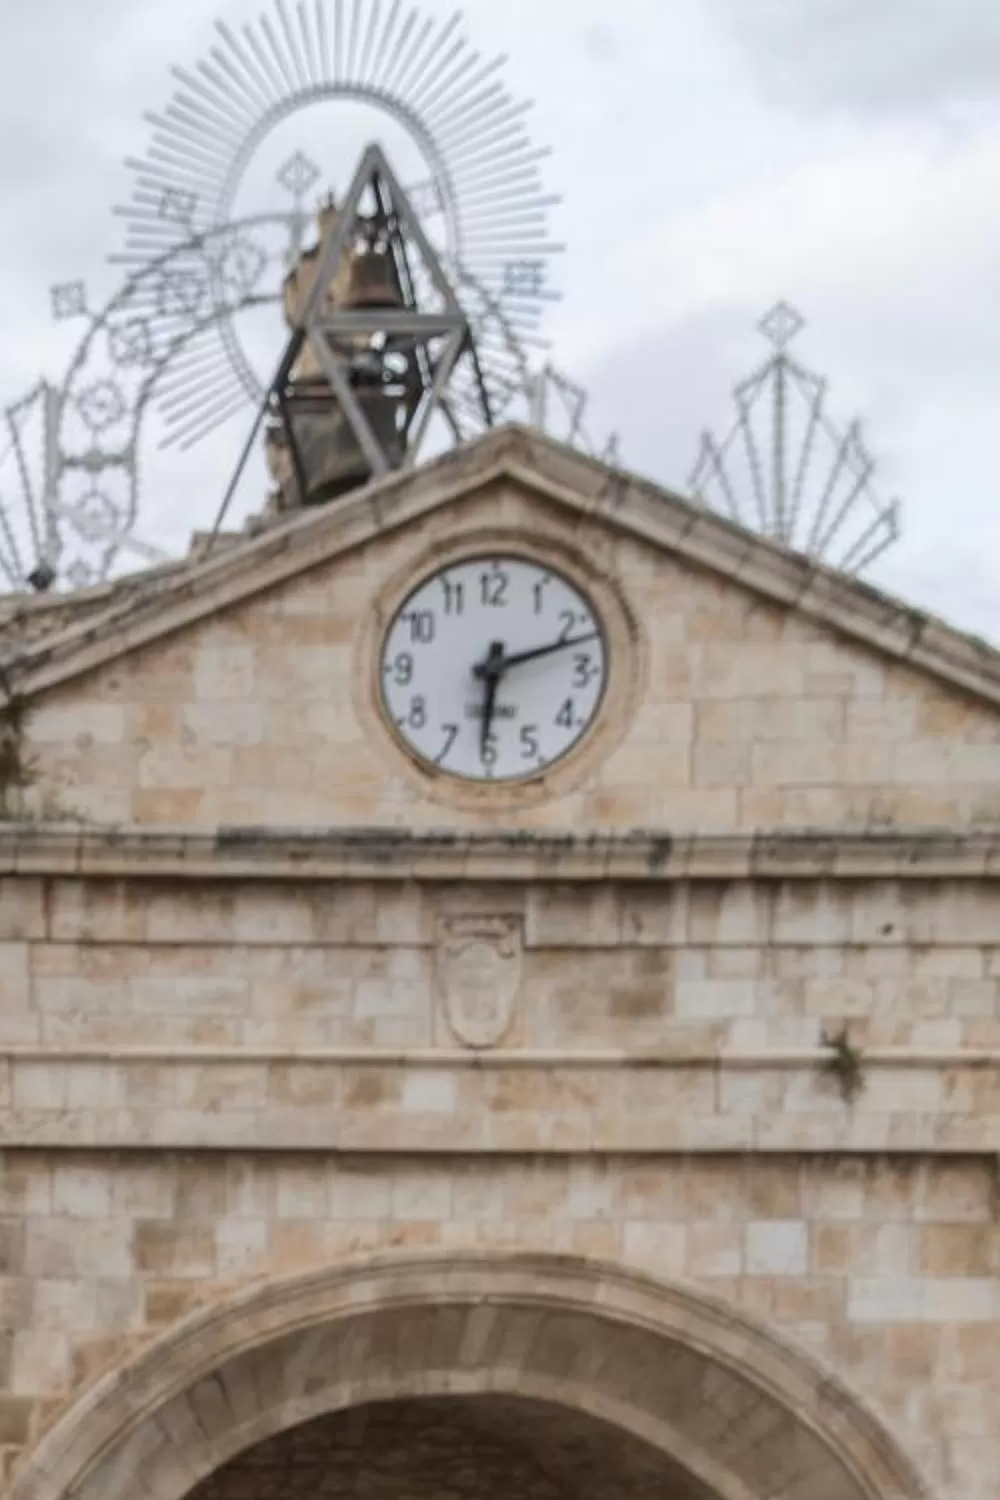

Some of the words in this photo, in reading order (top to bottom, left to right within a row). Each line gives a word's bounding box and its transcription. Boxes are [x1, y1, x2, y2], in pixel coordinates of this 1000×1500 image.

[480, 571, 509, 607] 12
[532, 582, 543, 615] 1
[408, 611, 435, 643] 10
[560, 610, 576, 644] 2
[395, 652, 412, 686] 9
[573, 653, 591, 688] 3
[408, 695, 425, 729] 8
[554, 697, 573, 729] 4
[439, 723, 459, 759] 7
[480, 731, 498, 765] 6
[520, 724, 538, 758] 5
